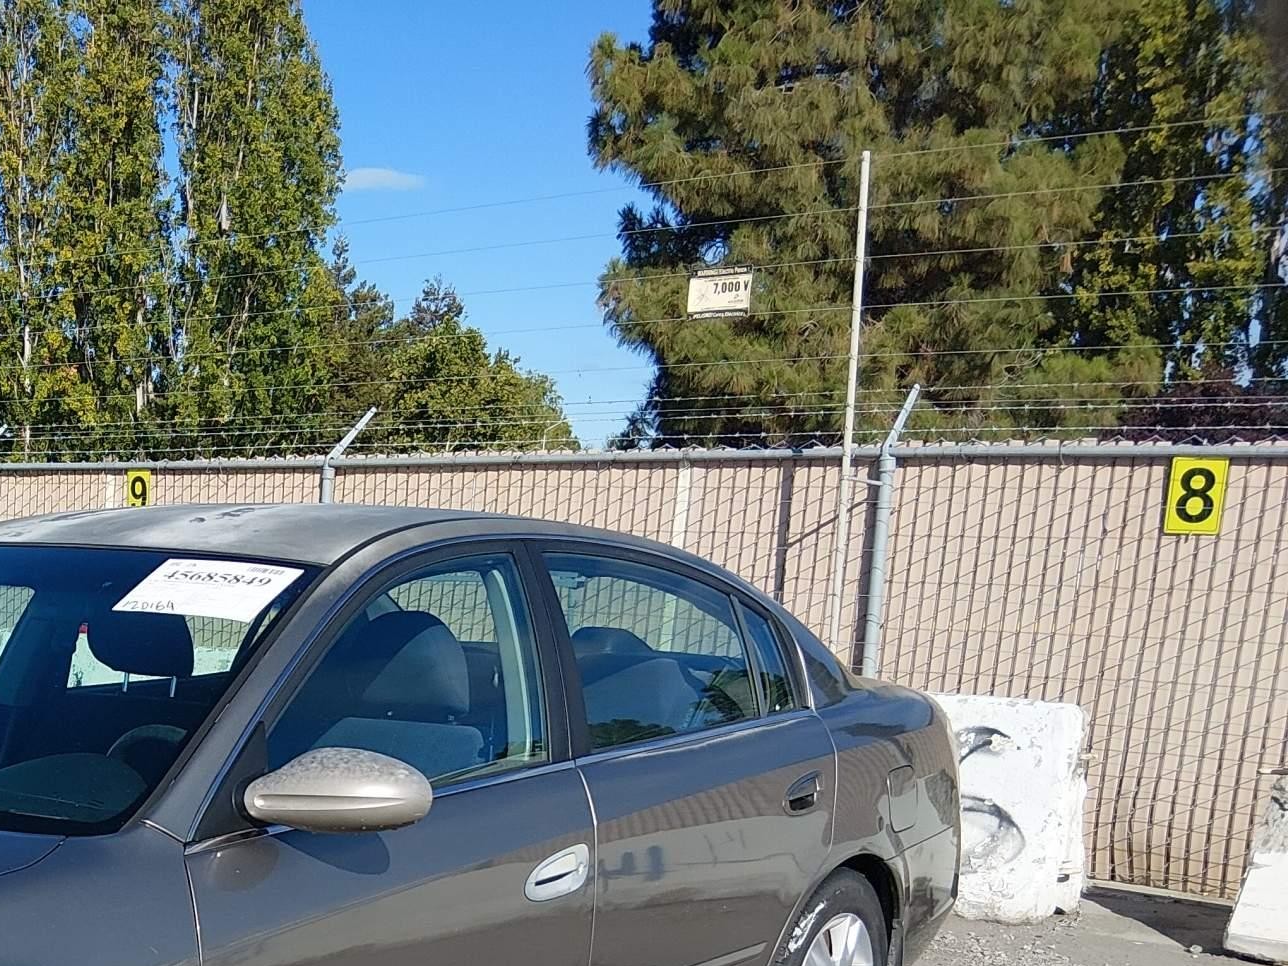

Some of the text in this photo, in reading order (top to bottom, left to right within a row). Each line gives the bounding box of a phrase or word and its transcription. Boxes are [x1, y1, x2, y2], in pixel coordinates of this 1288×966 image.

[713, 281, 741, 296] 7,000
[743, 279, 750, 292] V
[130, 475, 147, 506] 9
[1175, 466, 1216, 524] 8
[164, 570, 272, 586] 45685849
